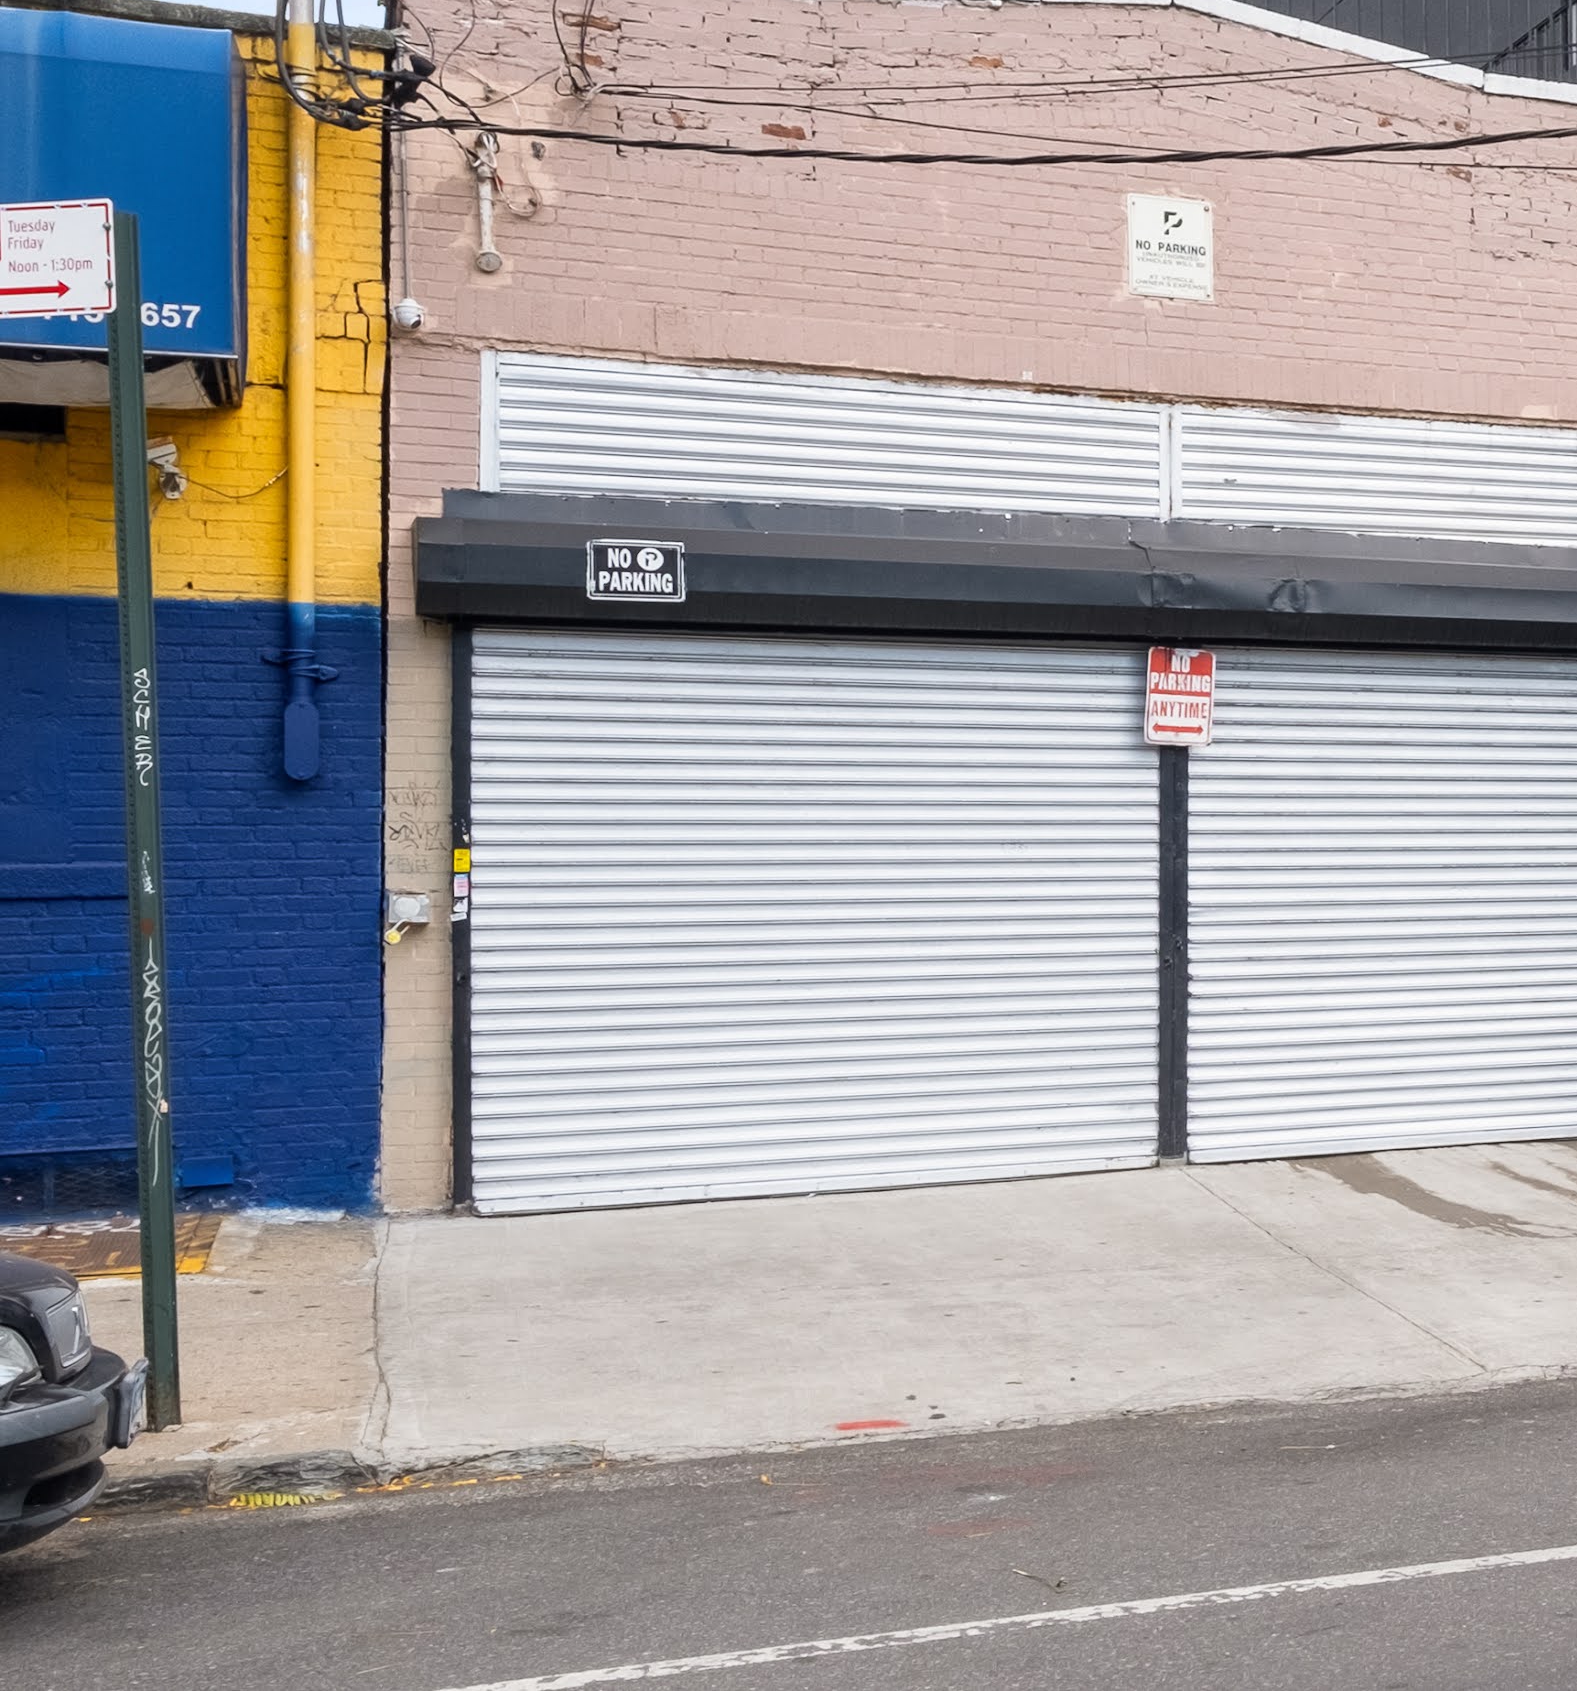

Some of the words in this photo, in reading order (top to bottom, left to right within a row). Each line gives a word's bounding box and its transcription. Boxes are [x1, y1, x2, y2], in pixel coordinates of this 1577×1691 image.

[8, 219, 55, 236] Tuesday
[7, 236, 44, 250] Friday
[1135, 239, 1151, 251] NO
[1158, 241, 1207, 256] PARKING
[8, 260, 39, 273] Noon
[51, 258, 93, 272] 1:30pm
[607, 547, 632, 569] NO
[598, 571, 673, 594] PARKING
[1171, 654, 1191, 673] NO
[1150, 671, 1212, 692] PARKING
[1151, 700, 1207, 719] ANYTIME
